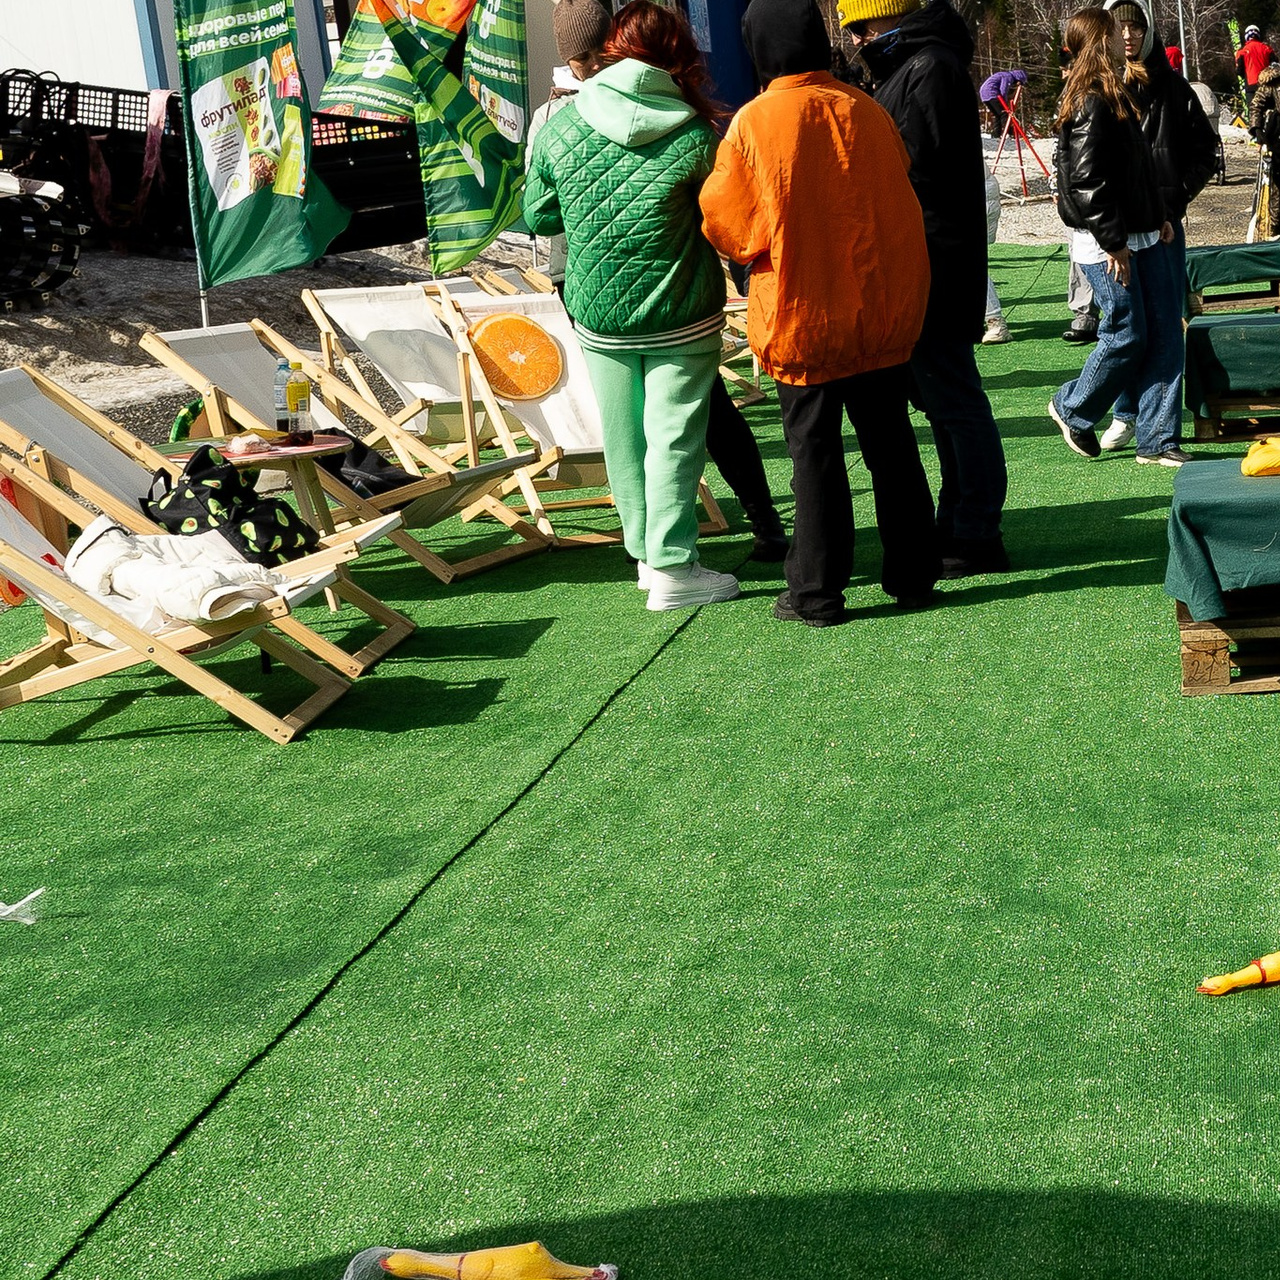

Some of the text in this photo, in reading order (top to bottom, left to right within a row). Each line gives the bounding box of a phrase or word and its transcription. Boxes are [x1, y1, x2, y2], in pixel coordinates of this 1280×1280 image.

[189, 39, 215, 60] для
[219, 26, 262, 48] всей
[200, 85, 267, 129] фрутилад
